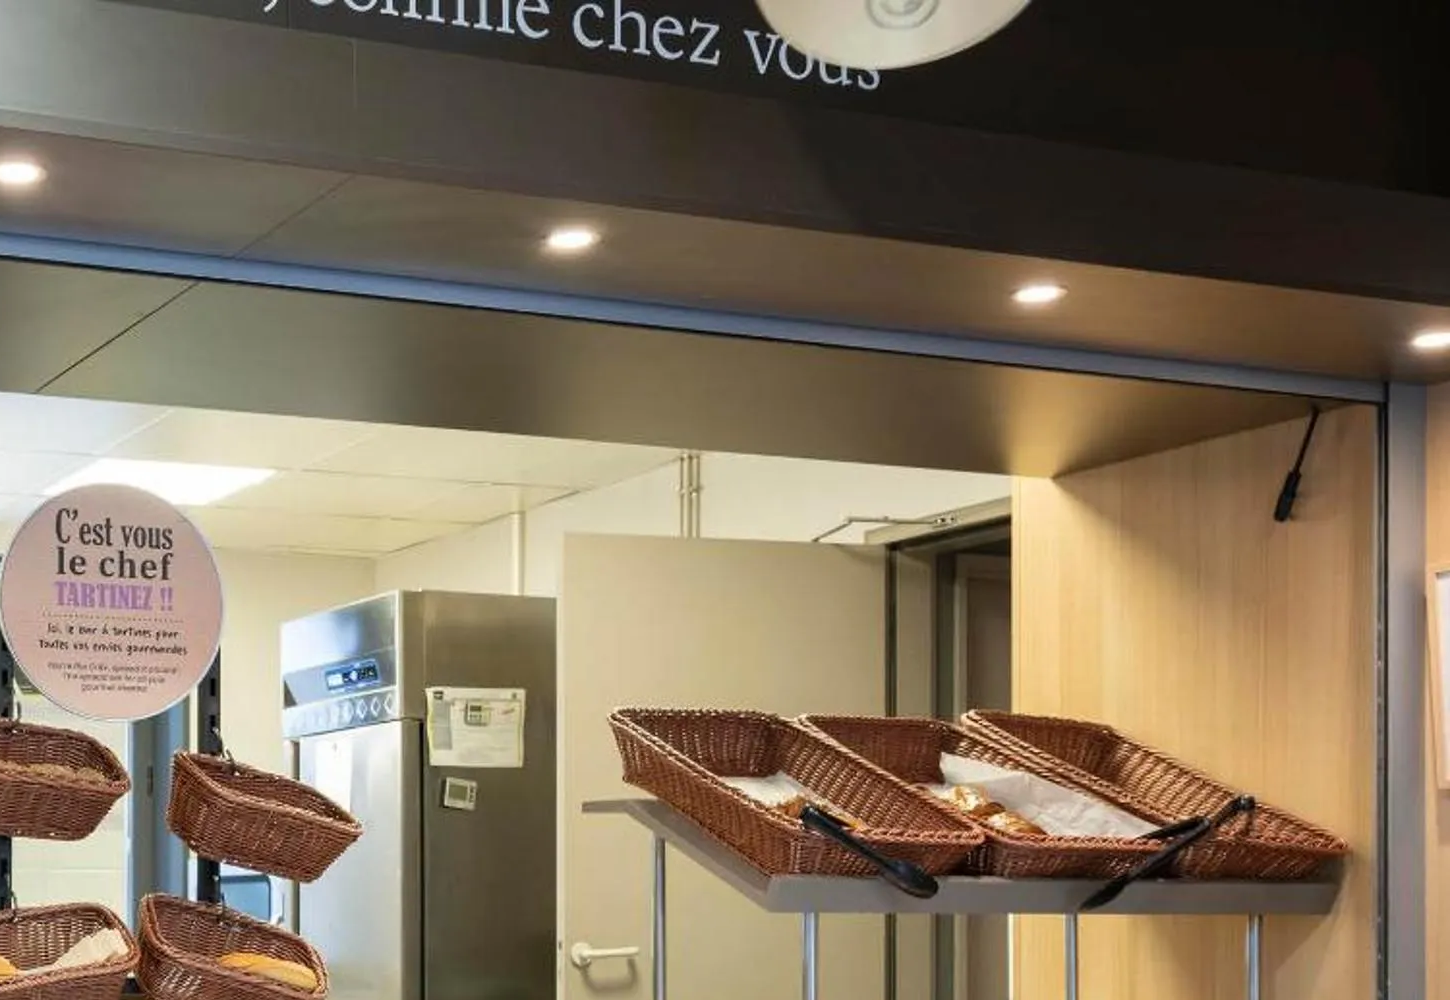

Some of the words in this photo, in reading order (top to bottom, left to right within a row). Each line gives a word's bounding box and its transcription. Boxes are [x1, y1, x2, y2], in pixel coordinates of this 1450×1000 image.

[572, 0, 721, 67] chez
[55, 507, 113, 546] C'est
[121, 525, 173, 550] vous
[56, 546, 86, 575] le
[99, 550, 174, 580] chef
[55, 581, 152, 610] TARTINEZ
